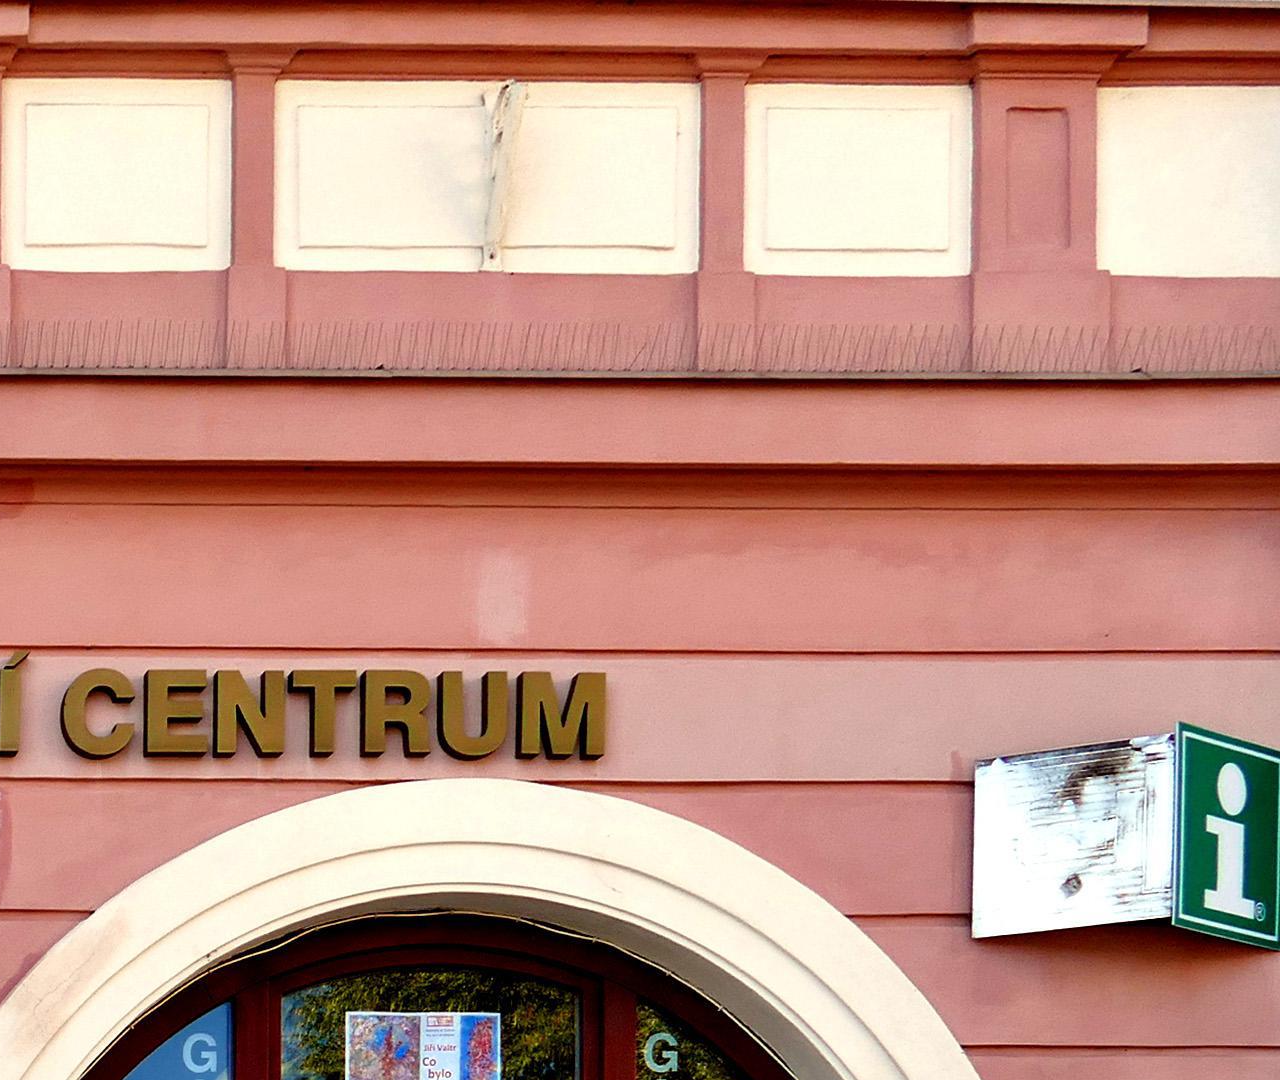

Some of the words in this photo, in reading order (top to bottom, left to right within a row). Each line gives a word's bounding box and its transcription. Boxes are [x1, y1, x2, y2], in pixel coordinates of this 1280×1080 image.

[59, 667, 609, 760] CENTRUM
[422, 1057, 437, 1067] Co
[428, 1068, 452, 1080] bylo
